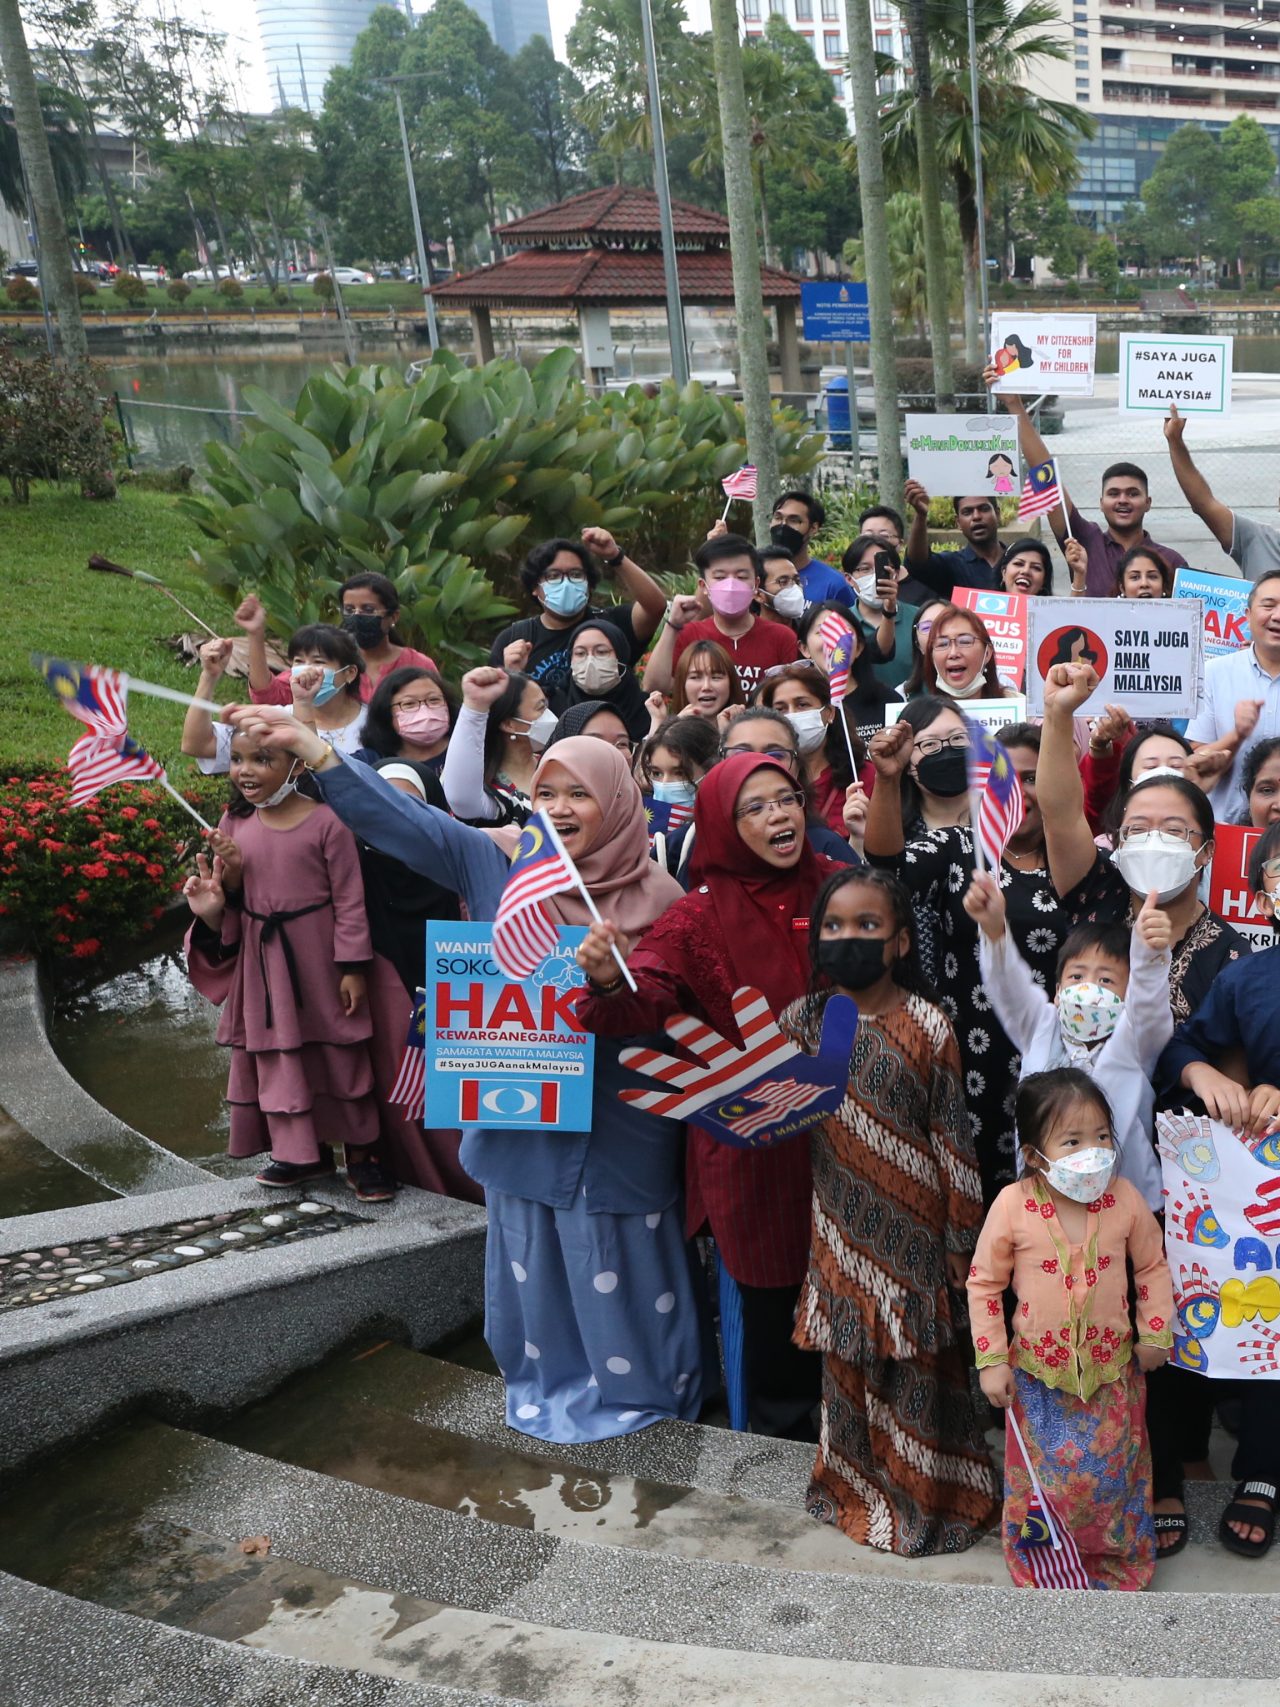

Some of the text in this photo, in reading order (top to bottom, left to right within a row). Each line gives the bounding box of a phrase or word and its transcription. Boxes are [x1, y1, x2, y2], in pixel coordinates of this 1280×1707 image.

[1037, 336, 1094, 346] MY CITIZENSHIP
[1058, 349, 1071, 358] FOR
[1135, 351, 1216, 363] #SAYA JUGA
[1040, 362, 1088, 372] MY CHILDREN
[1157, 371, 1193, 381] ANAK
[1139, 389, 1211, 400] MALAYSIA#
[1180, 580, 1212, 593] WANITA
[1115, 630, 1189, 648] SAYA JUGA
[1114, 652, 1150, 669] ANAK
[1114, 674, 1182, 691] MALAYSIA
[436, 982, 588, 1033] HAK
[436, 1031, 587, 1045] KEWARGANEGARAAN
[436, 1047, 584, 1061] SAMARATA WANITA MALAYSIA
[440, 1061, 580, 1072] #SayaJUGAanakMalaysia
[774, 1110, 830, 1137] MALAYSIA
[1244, 1481, 1276, 1499] PUMA
